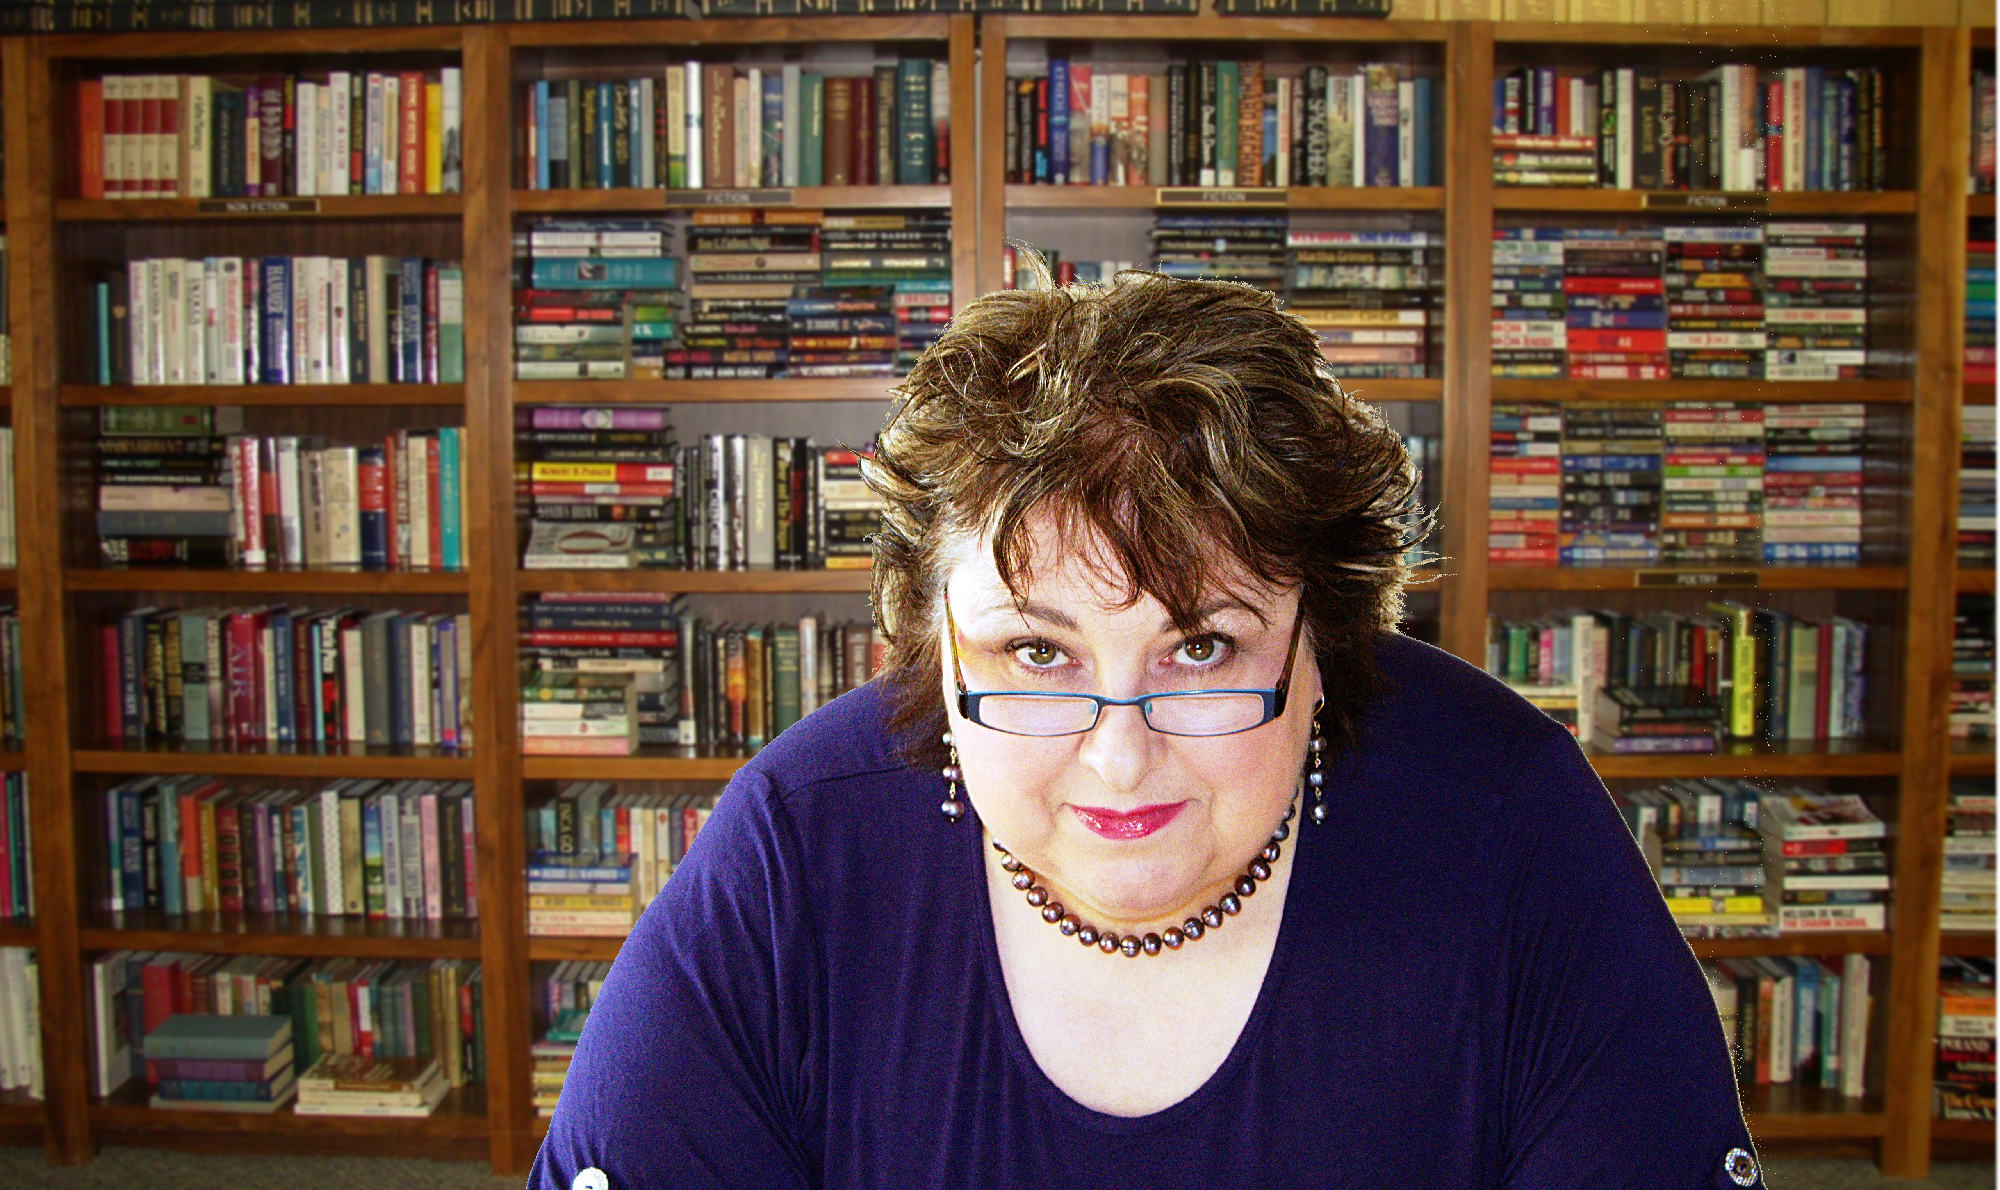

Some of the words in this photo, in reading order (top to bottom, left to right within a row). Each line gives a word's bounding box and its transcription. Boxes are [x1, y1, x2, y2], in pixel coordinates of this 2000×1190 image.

[1307, 99, 1325, 177] SPYCATCHER
[707, 193, 749, 204] FICTION
[1203, 191, 1246, 202] FICTION
[1688, 196, 1726, 207] FICTION
[226, 201, 247, 212] NON
[249, 201, 289, 212] FICTION
[1677, 573, 1718, 585] POETRY
[560, 803, 573, 829] INCA
